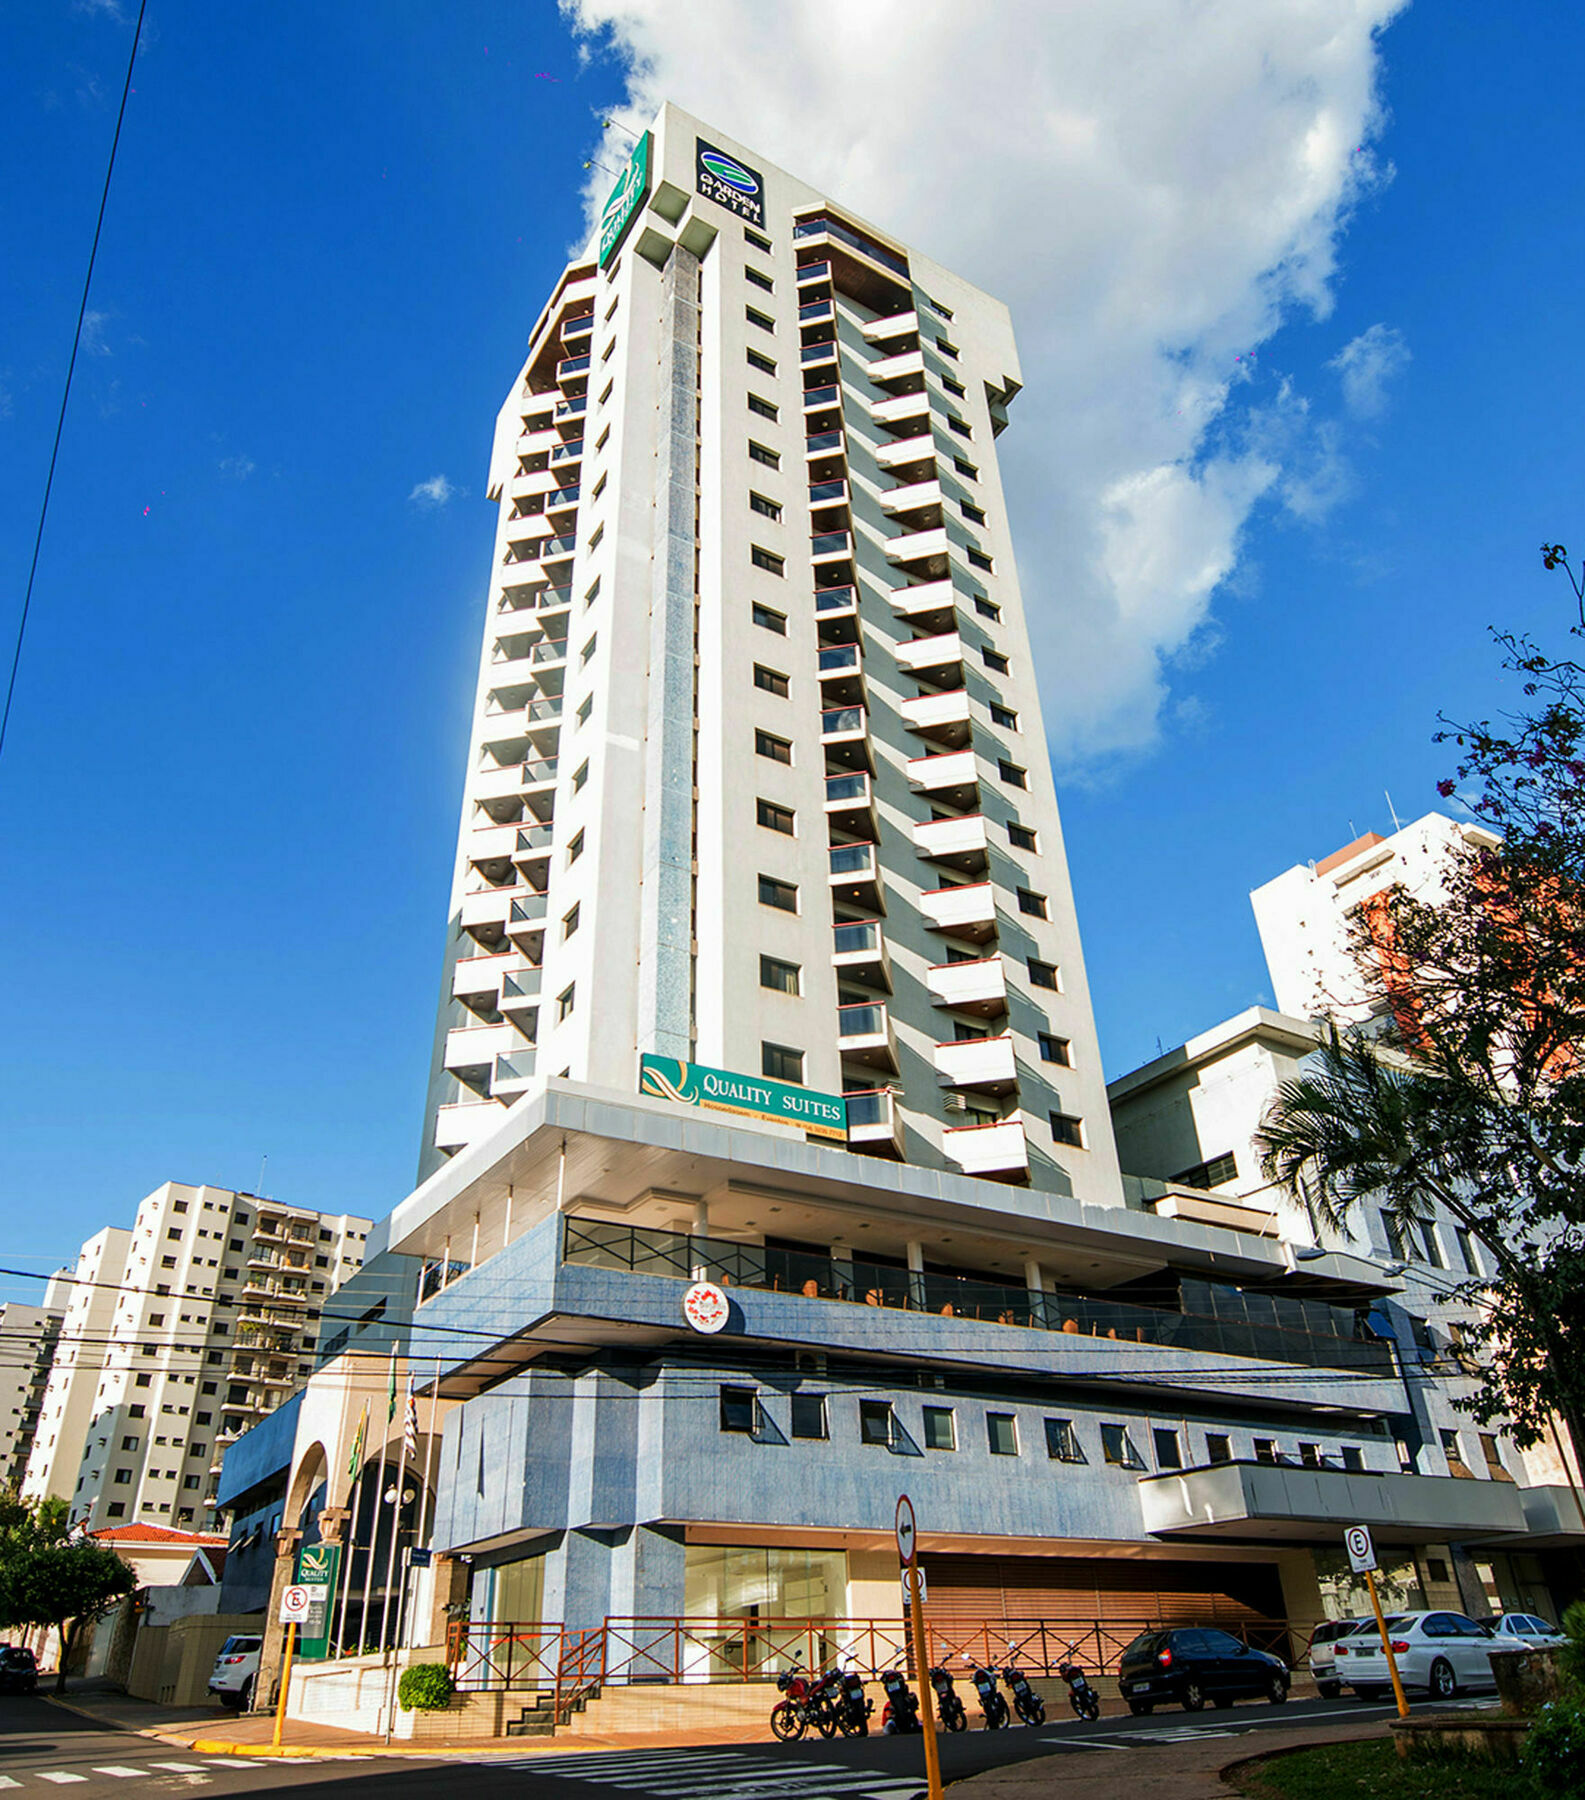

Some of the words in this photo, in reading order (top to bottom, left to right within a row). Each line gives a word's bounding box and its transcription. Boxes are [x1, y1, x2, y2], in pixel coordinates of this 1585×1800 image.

[700, 173, 761, 214] GARDEN
[702, 183, 761, 223] HOTEL
[703, 1073, 772, 1105] QUALITY
[782, 1095, 841, 1121] SUITES
